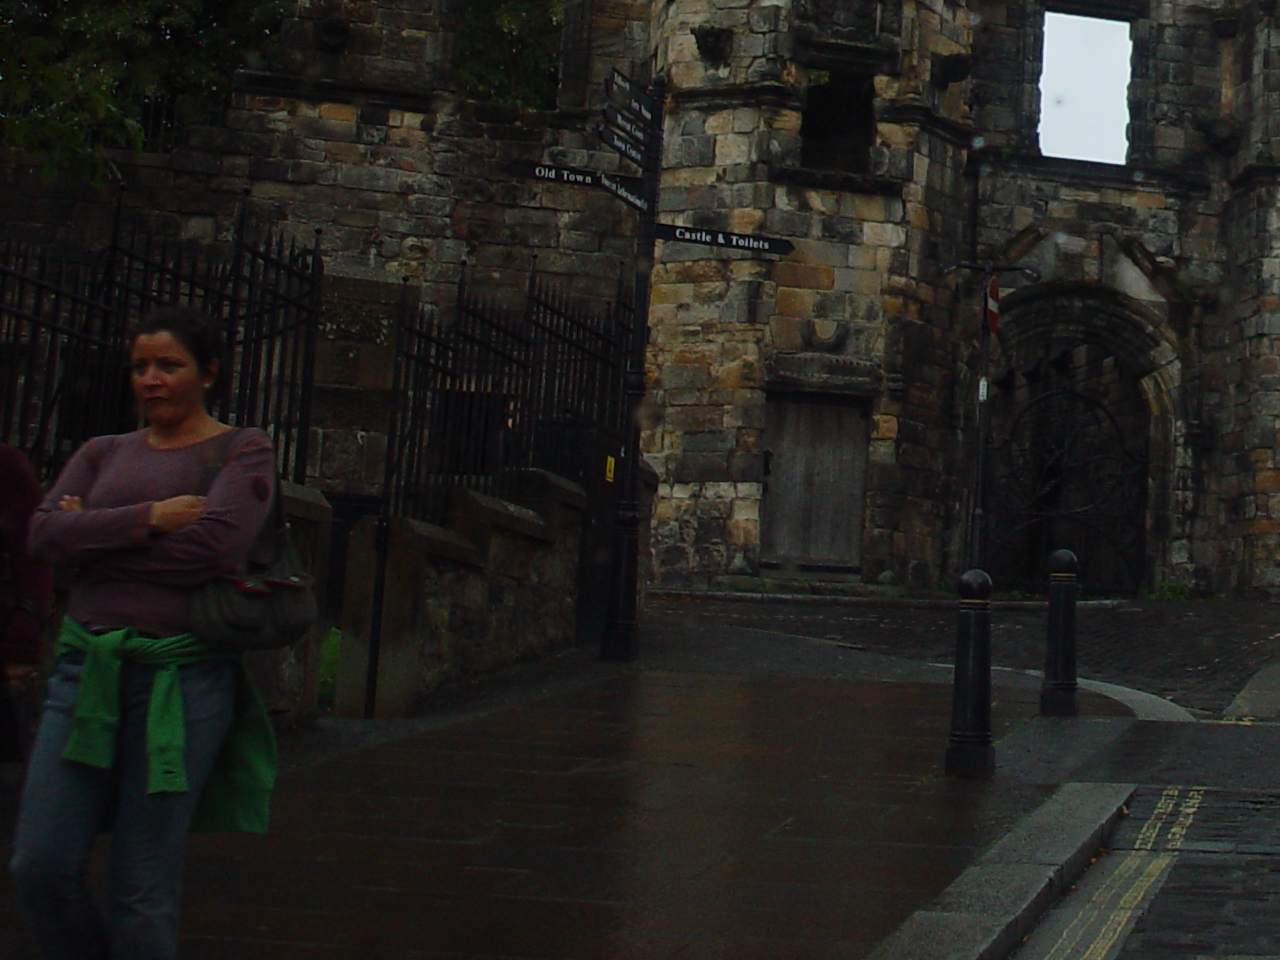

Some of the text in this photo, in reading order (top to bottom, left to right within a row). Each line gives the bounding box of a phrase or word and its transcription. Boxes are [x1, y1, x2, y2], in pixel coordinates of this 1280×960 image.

[535, 167, 592, 184] Old Town
[675, 228, 770, 250] Castle & Toilets
